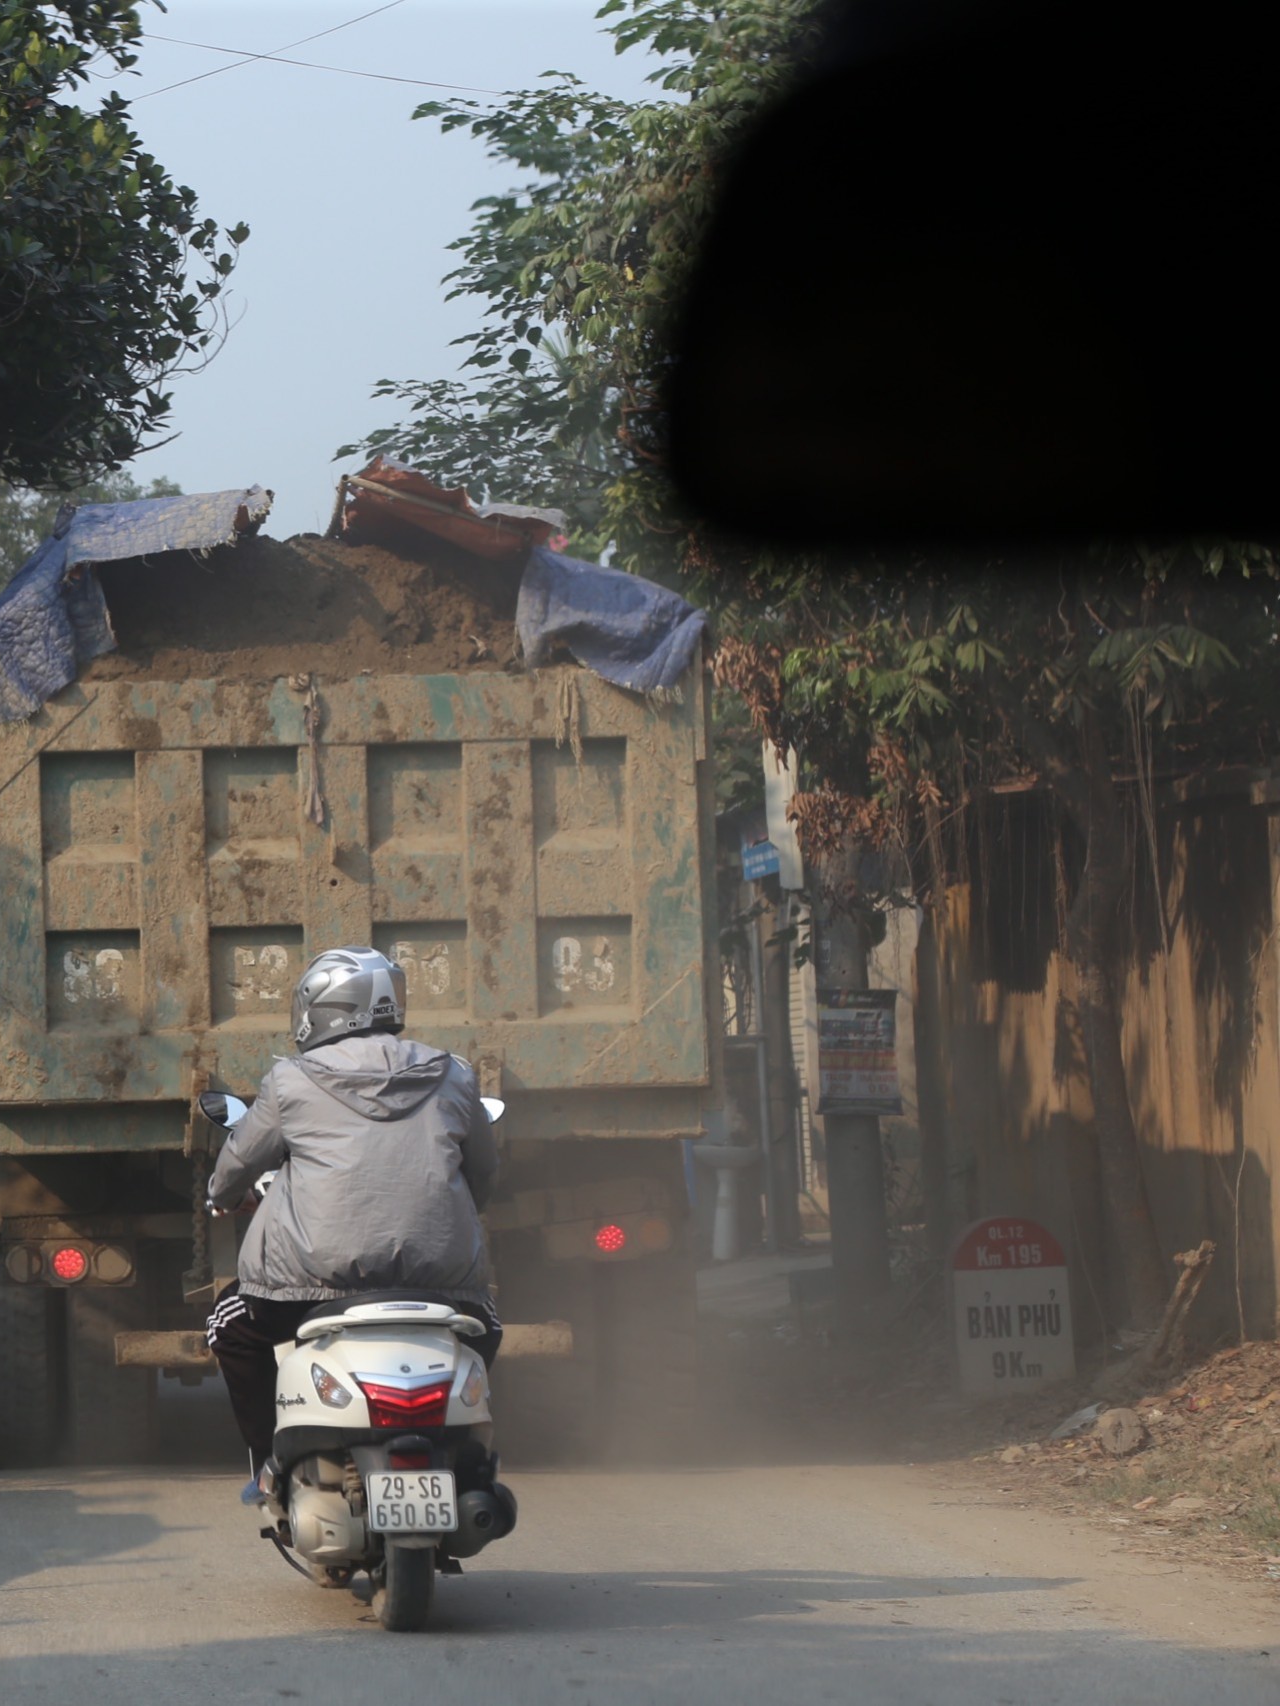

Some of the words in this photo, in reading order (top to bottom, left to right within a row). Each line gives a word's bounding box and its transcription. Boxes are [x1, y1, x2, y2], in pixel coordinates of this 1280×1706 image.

[976, 1246, 1002, 1267] Km
[1007, 1244, 1042, 1265] 195
[381, 1476, 442, 1500] 29-S6
[376, 1503, 452, 1528] 650.65
